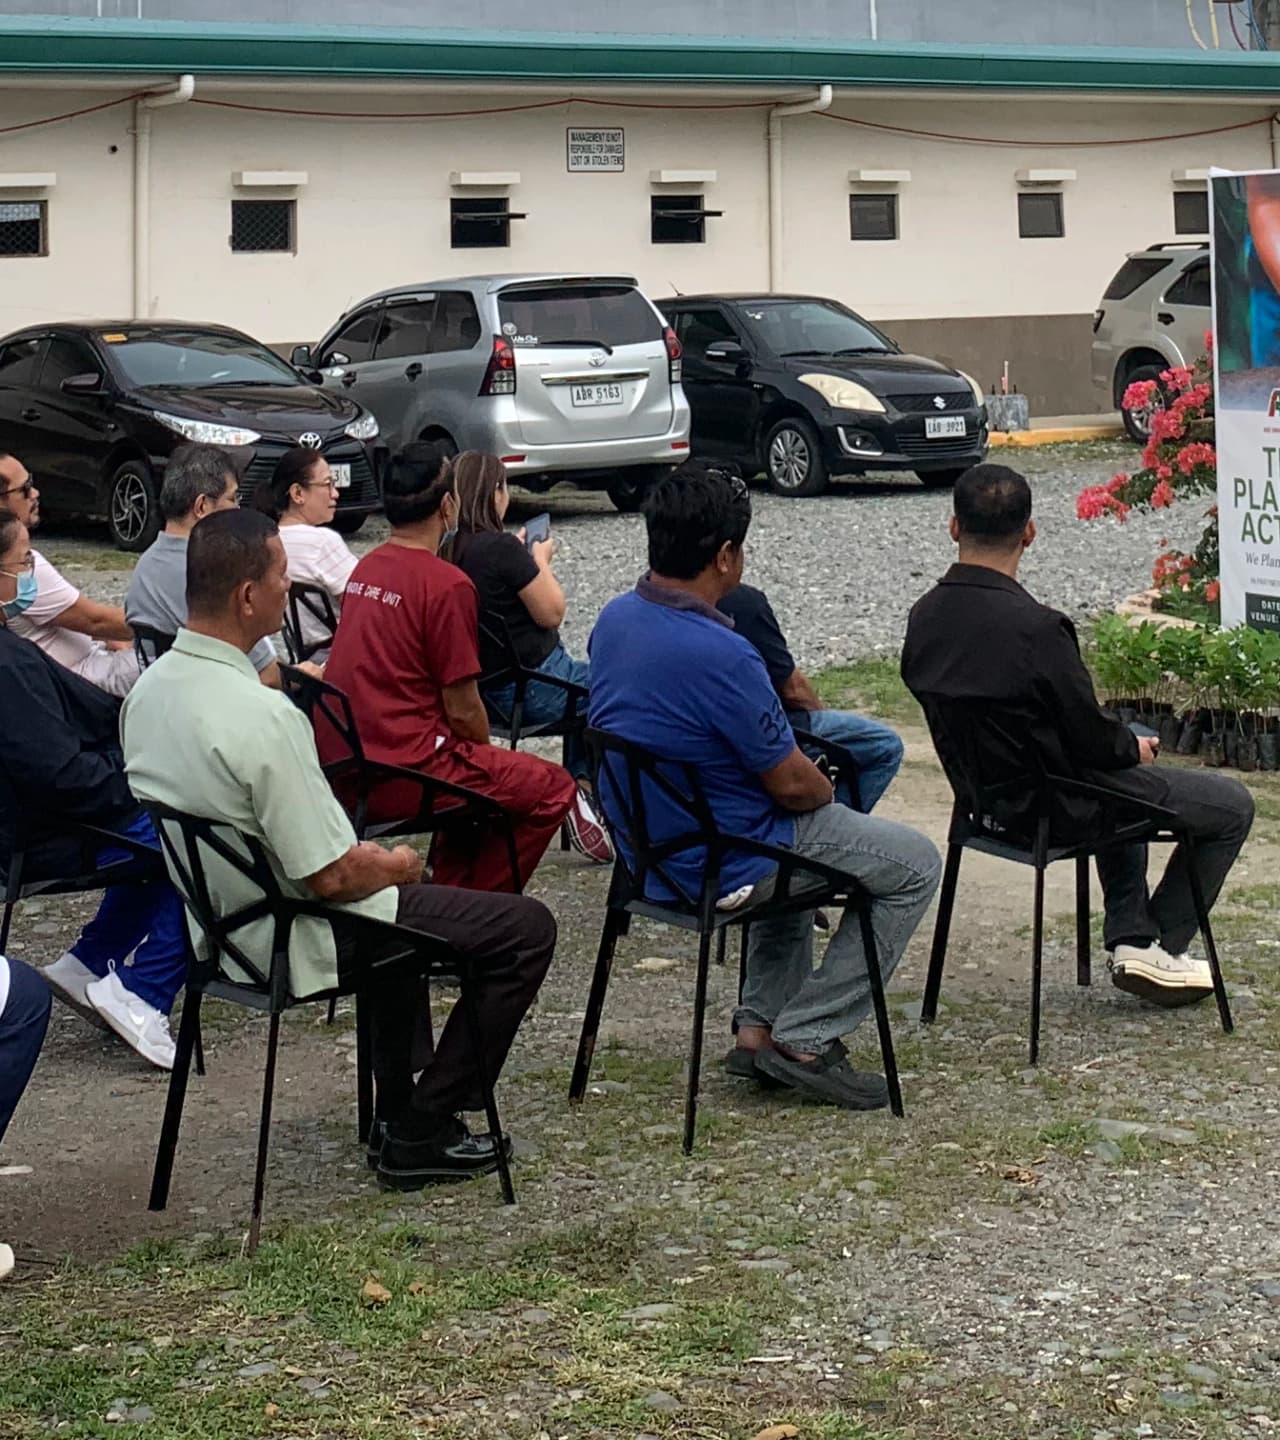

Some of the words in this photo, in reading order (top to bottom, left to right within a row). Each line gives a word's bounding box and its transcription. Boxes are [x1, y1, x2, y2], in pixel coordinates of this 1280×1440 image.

[576, 389, 593, 401] ABR
[596, 387, 620, 398] 5163
[1245, 551, 1259, 565] We
[382, 591, 402, 608] UNIT
[1250, 612, 1278, 623] VENUE:
